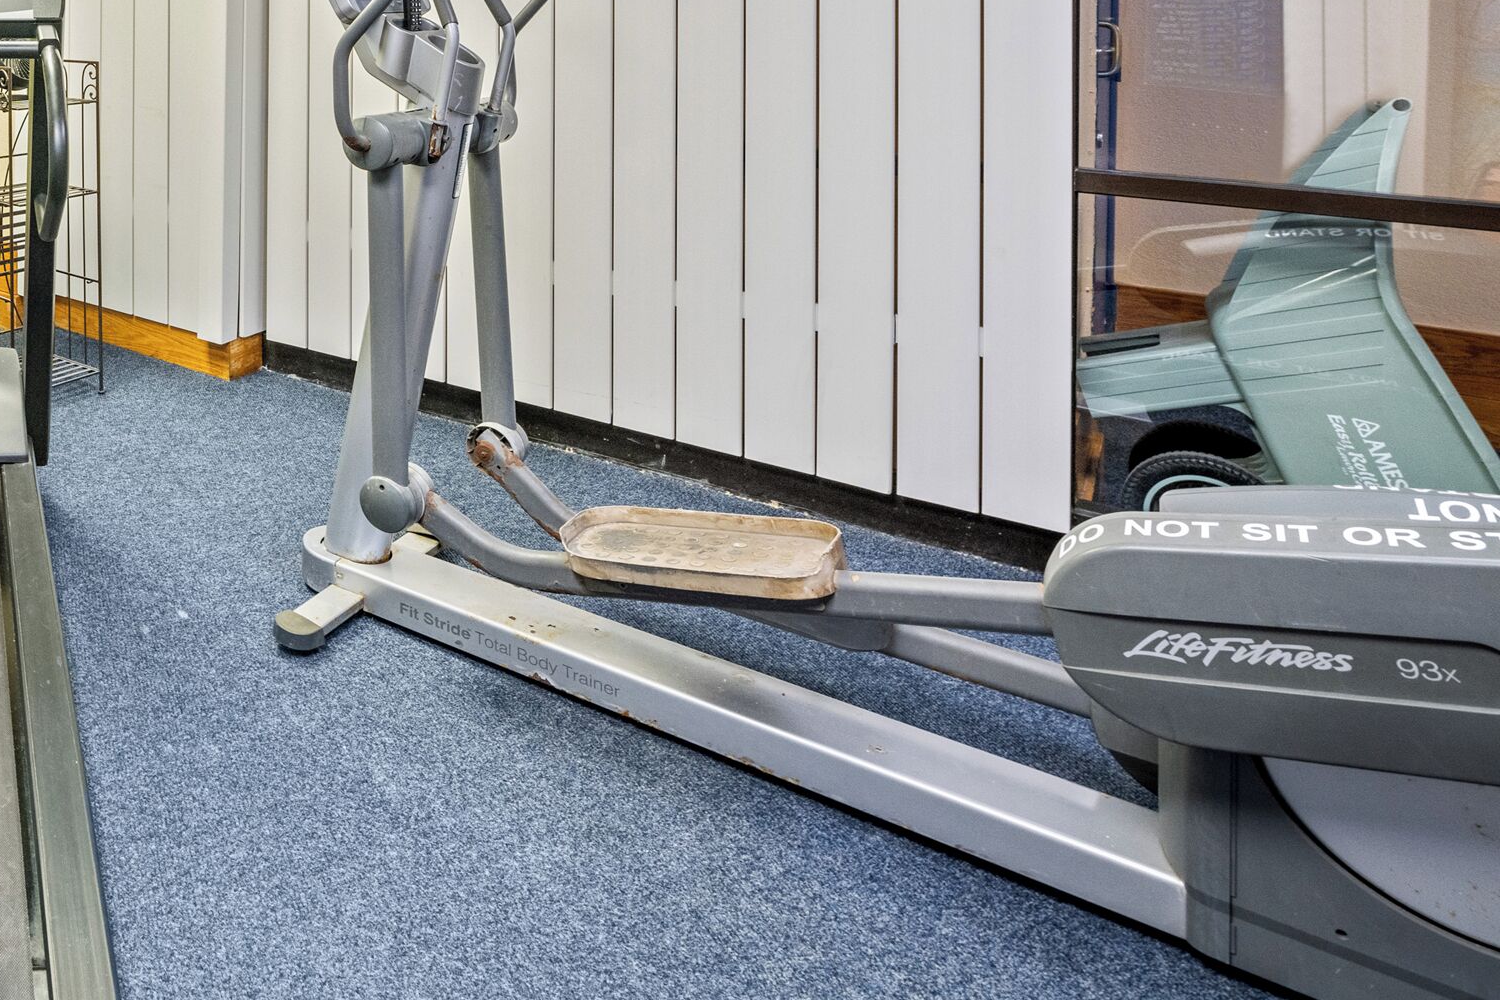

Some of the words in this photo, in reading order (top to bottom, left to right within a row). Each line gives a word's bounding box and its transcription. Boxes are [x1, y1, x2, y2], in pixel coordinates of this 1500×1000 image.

[1327, 414, 1355, 453] Easy
[1363, 439, 1410, 490] AMES
[1058, 523, 1105, 559] DO
[1124, 519, 1220, 539] NOT
[1241, 523, 1319, 543] SIT
[1342, 526, 1427, 549] OR
[399, 603, 420, 621] Fit
[423, 611, 472, 640] Stride
[475, 631, 512, 657] Total
[517, 647, 558, 676] Body
[562, 663, 621, 698] Trainer
[1396, 658, 1462, 685] 93x
